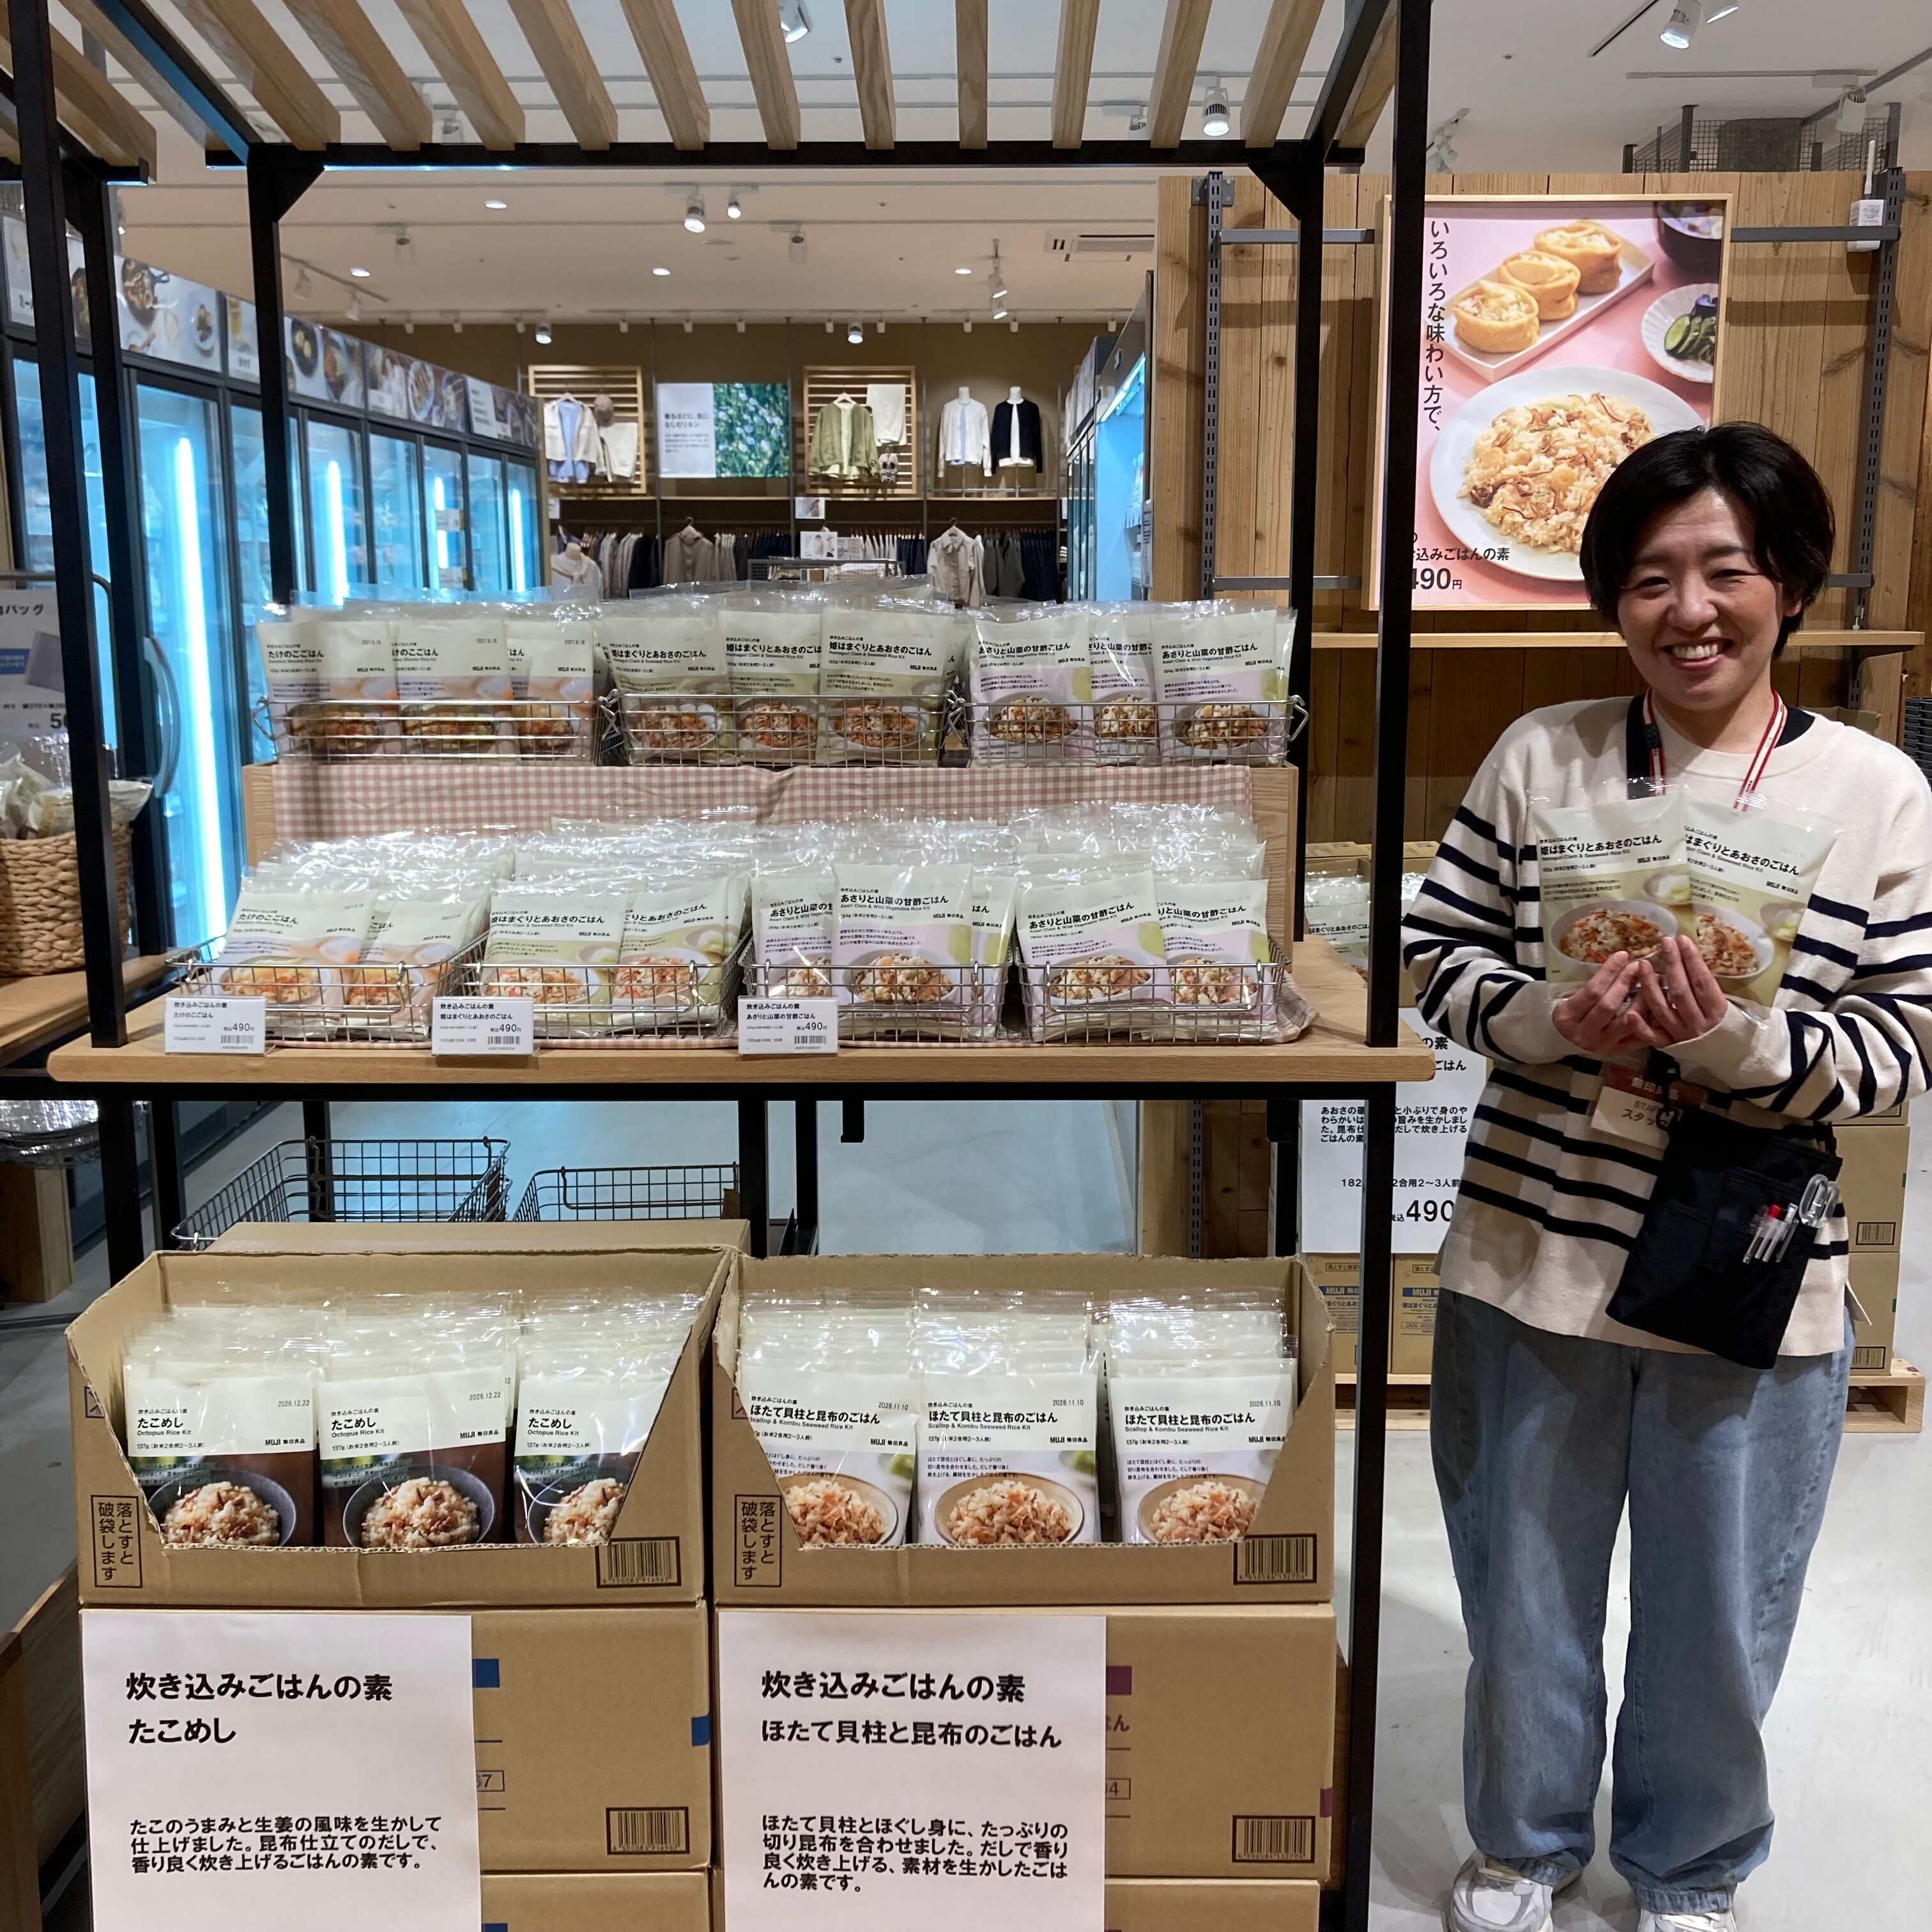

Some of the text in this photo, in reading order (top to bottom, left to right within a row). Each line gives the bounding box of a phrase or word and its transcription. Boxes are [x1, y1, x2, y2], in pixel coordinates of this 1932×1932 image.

[1423, 220, 1449, 432] いろいろな味わい方で、
[1413, 548, 1510, 561] 込みごはんの素
[268, 649, 325, 659] たけのこごはん
[829, 641, 932, 656] 姫はまぐりとあおさのごはん
[1162, 643, 1258, 659] あさりと山菜の甘酢ごはん
[1540, 834, 1662, 855] 姫はまぐりとあおさのごはん
[840, 894, 949, 906] あさりと山菜の甘酢ごはん
[239, 914, 298, 924] たけのこごはん
[1029, 902, 1134, 929] あさりと山菜の甘酢ごはん
[1395, 1116, 1468, 1124] 旨みを生かしまし
[137, 1417, 184, 1429] たこめし
[331, 1417, 376, 1431] たこめし
[528, 1417, 572, 1429] たこめし
[749, 1416, 771, 1424] Scallop
[751, 1405, 880, 1425] ほたて貝柱と昆布のごはん
[928, 1411, 1058, 1424] ほたて貝柱と昆布のごはん
[1125, 1413, 1255, 1425] ほたて貝柱と昆布のごはん
[98, 1501, 117, 1581] 破袋します
[116, 1502, 134, 1565] 落とすと
[741, 1501, 758, 1581] 破袋します
[759, 1501, 776, 1565] 落とすと
[125, 1672, 393, 1701] 炊き込みごはんの素
[761, 1670, 1025, 1703] 炊き込みごはんの素
[128, 1717, 236, 1744] たこめし
[761, 1719, 1062, 1749] ほたて貝柱と昆布のごはん
[130, 1816, 441, 1835] たこのうまみと生姜の風味を生かして
[762, 1814, 1068, 1838] ほたて貝柱とほぐし身に、たっぷりの
[130, 1834, 437, 1855] 仕上げました。昆布仕立てのだしで、
[762, 1834, 1068, 1859] 切り昆布を合わせました。だしで香り
[132, 1853, 422, 1874] 香り良く炊き上げるごはんの素です。
[763, 1853, 1068, 1879] 良く炊き上げる、素材を生かしたごは
[763, 1872, 861, 1892] んの素です。
